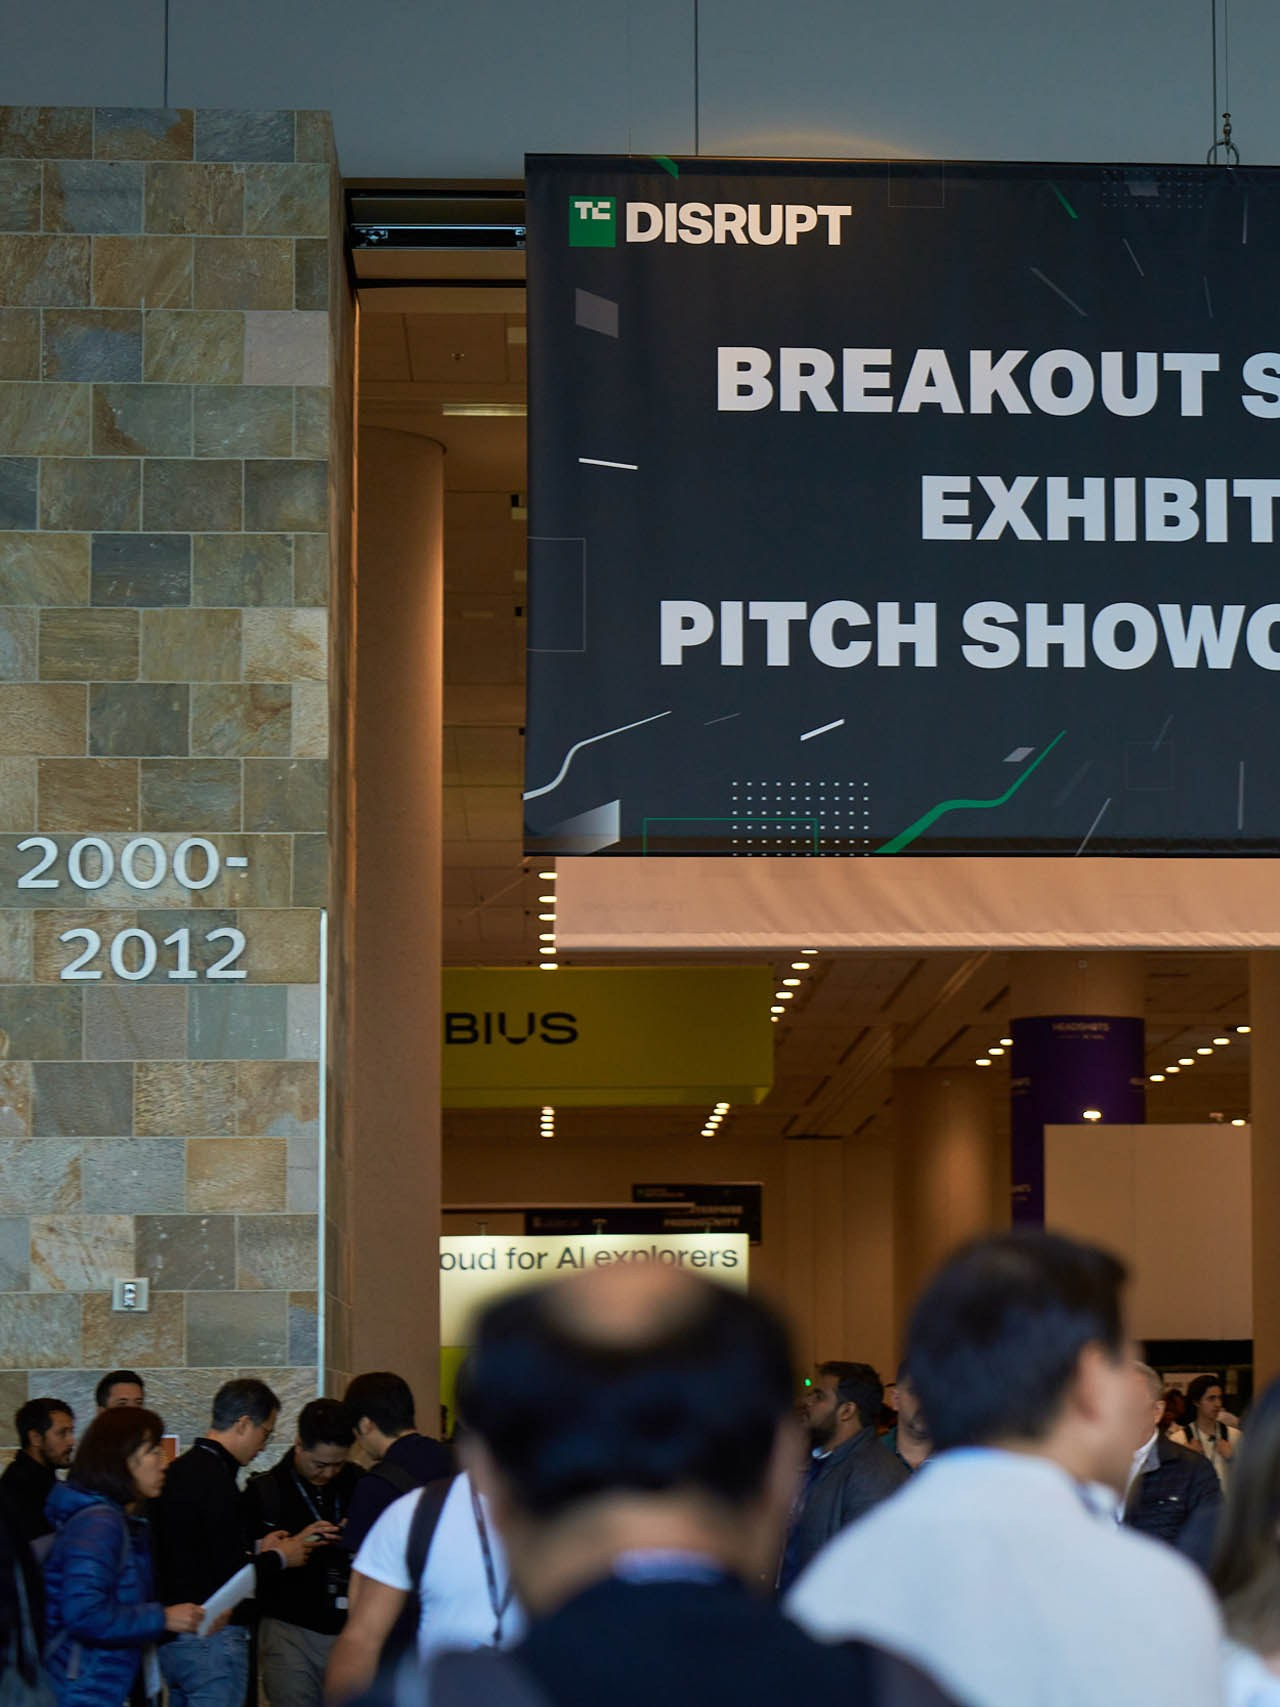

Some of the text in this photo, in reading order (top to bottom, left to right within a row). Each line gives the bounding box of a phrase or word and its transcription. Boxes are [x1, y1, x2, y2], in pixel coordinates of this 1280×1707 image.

[574, 201, 852, 246] TC DISRUPT
[717, 346, 1220, 417] BREAKOUT
[660, 599, 938, 668] PITCH
[16, 836, 249, 890] 2000-
[58, 926, 249, 981] 2012
[445, 1012, 579, 1045] BIUS
[440, 1245, 738, 1271] oud for AI explorers
